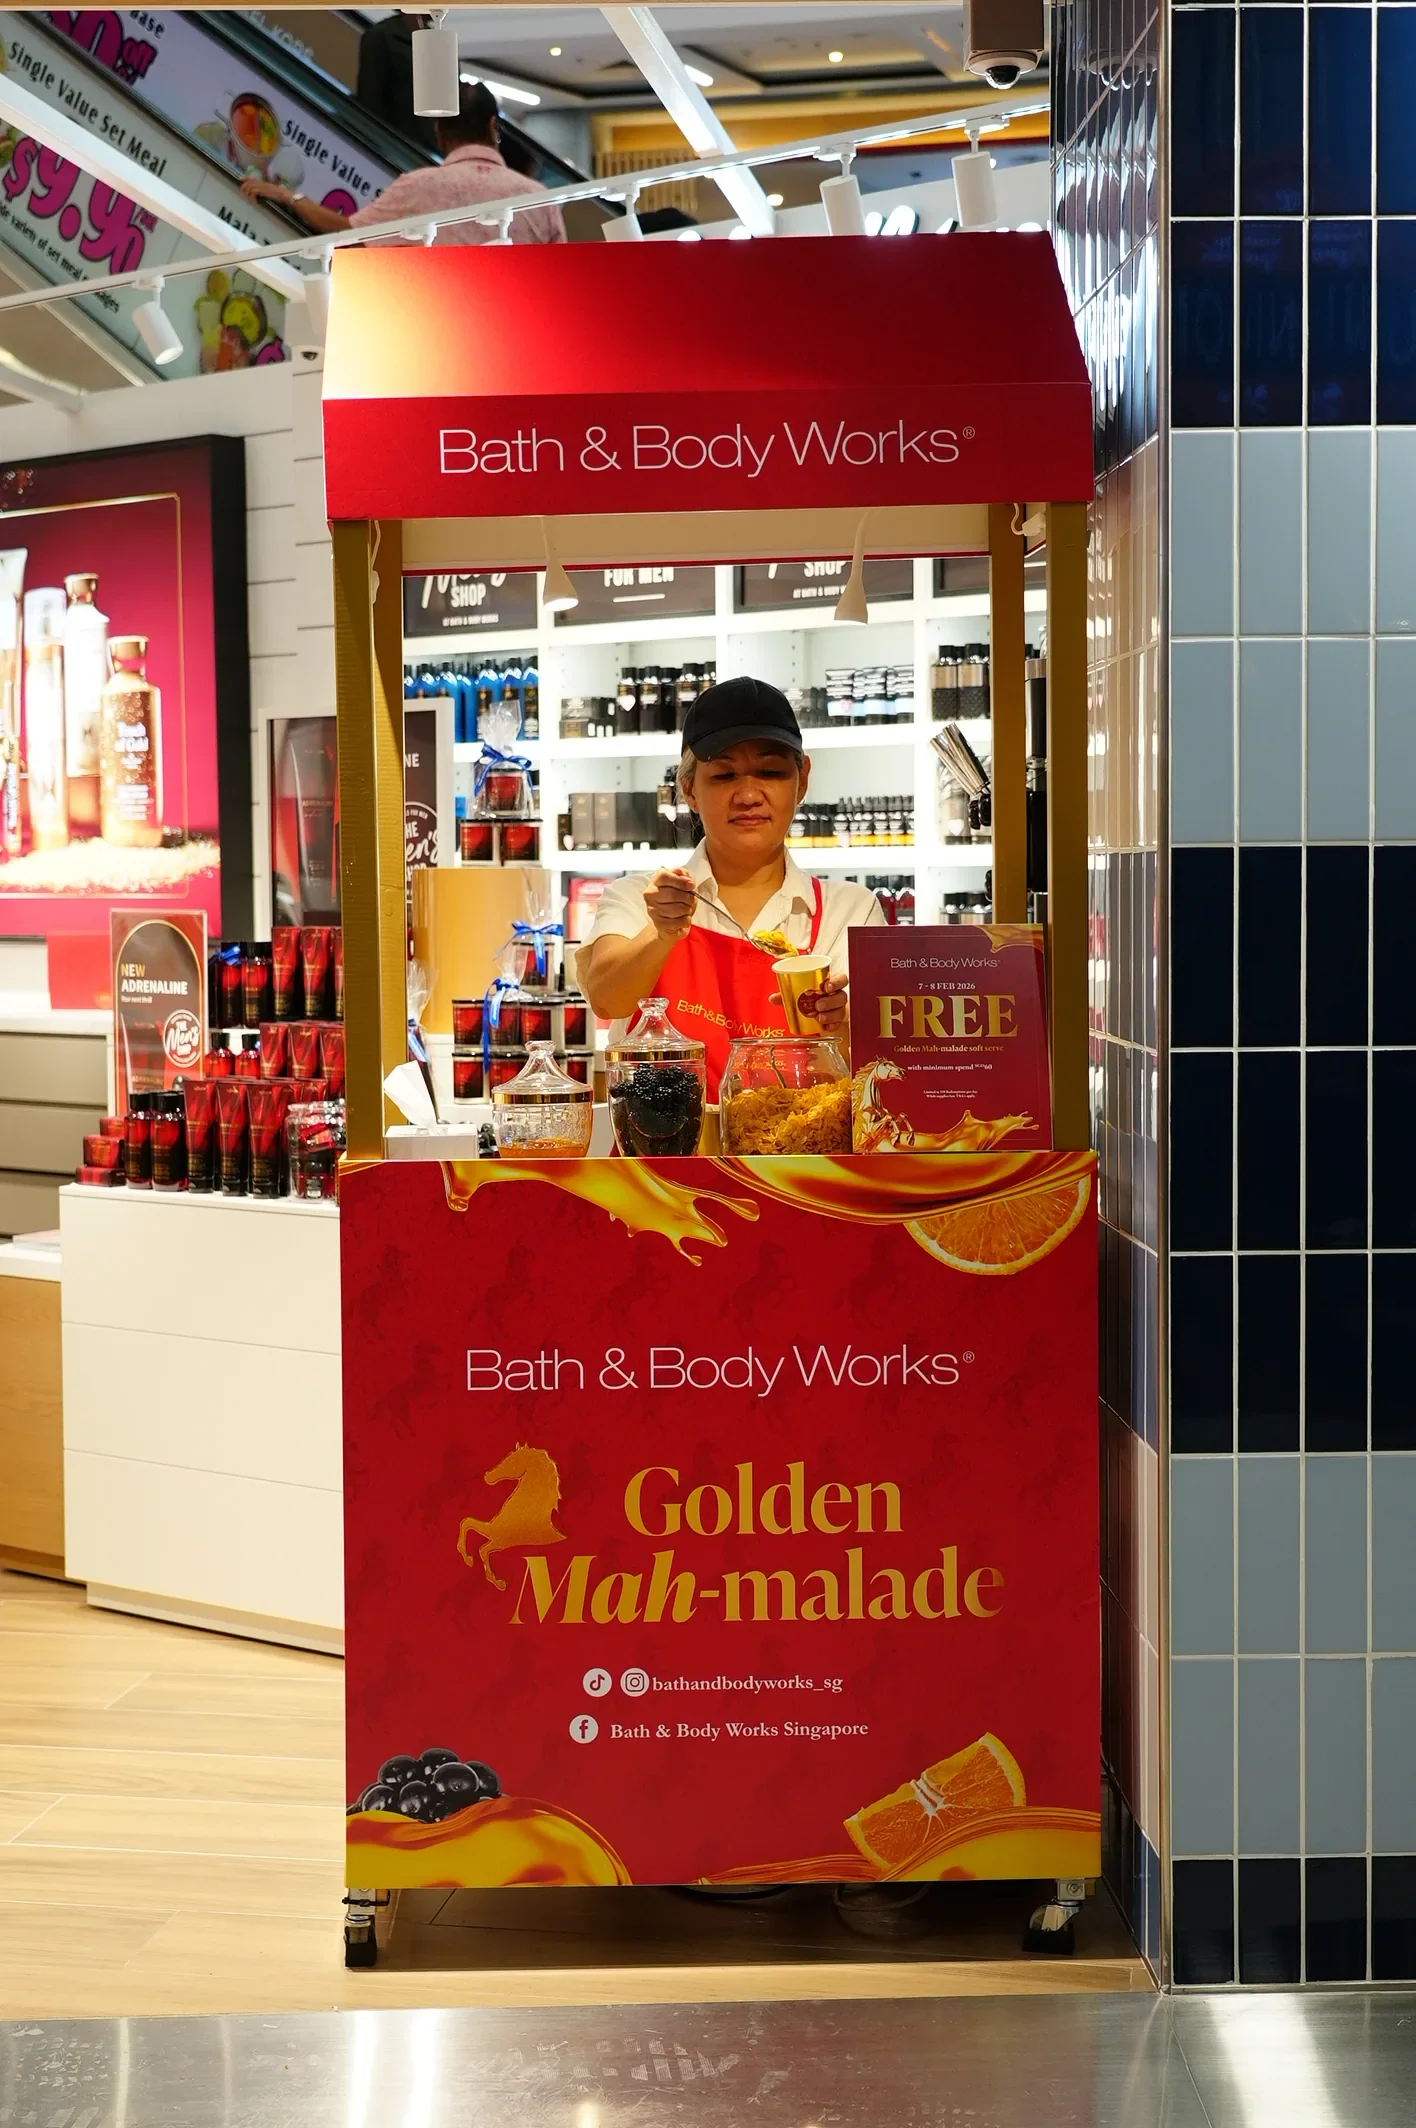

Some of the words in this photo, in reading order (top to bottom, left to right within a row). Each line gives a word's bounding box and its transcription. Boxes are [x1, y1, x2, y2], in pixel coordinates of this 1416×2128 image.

[8, 41, 55, 89] Single
[57, 78, 99, 124] Value
[100, 114, 126, 146] Set
[126, 136, 167, 177] Meal
[281, 119, 329, 165] Single
[330, 154, 371, 197] Value
[439, 428, 564, 474] Bath
[580, 426, 622, 471] &
[633, 424, 775, 478] Body
[450, 582, 487, 608] SHOP
[404, 820, 420, 840] HE
[120, 963, 146, 977] NEW
[890, 957, 917, 969] Bath
[918, 957, 929, 968] &
[929, 957, 960, 970] Body
[121, 979, 189, 996] ADRENALINE
[936, 982, 956, 990] FEB
[956, 982, 976, 990] 2026
[676, 999, 708, 1019] Bath
[706, 1010, 717, 1022] &
[876, 994, 1019, 1039] FREE
[893, 1044, 920, 1053] Golden
[921, 1044, 968, 1053] Mah-malade
[968, 1043, 984, 1052] soft
[955, 1064, 974, 1072] spend
[466, 1348, 584, 1391] Bath
[598, 1347, 639, 1390] &
[650, 1346, 785, 1397] Body
[624, 1461, 903, 1537] Golden
[510, 1545, 1005, 1625] Mah-malade
[652, 1674, 844, 1694] bathandbodyworks_sg
[610, 1724, 650, 1739] Bath
[655, 1724, 671, 1738] &
[676, 1722, 721, 1742] Body
[725, 1722, 779, 1737] Works
[783, 1721, 869, 1741] Singapore
